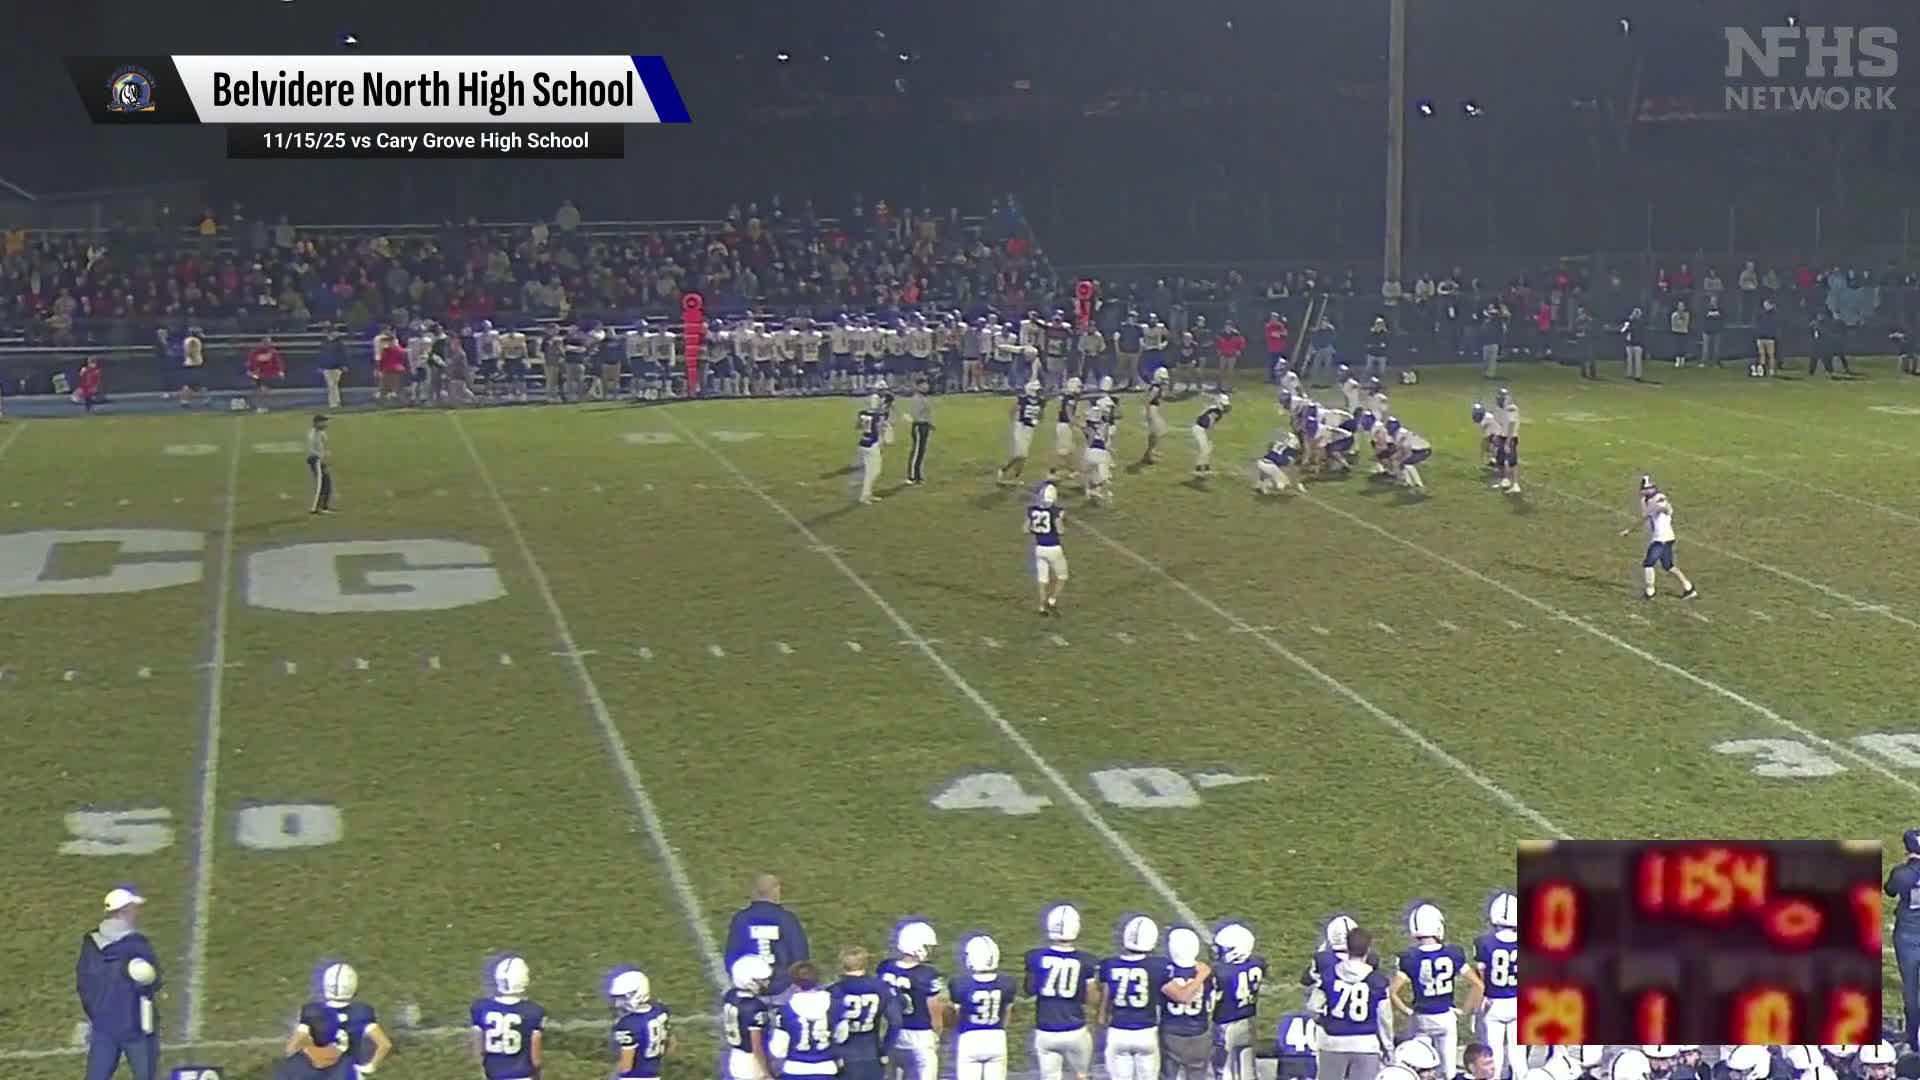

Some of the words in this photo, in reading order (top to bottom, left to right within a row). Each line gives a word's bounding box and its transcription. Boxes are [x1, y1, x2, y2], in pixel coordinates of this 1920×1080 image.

[1031, 510, 1050, 533] 23
[1041, 956, 1081, 998] 70
[1111, 967, 1149, 1008] 73
[1419, 957, 1454, 997] 42
[969, 989, 1002, 1025] 31
[1331, 979, 1370, 1022] 78
[485, 1011, 522, 1055] 26
